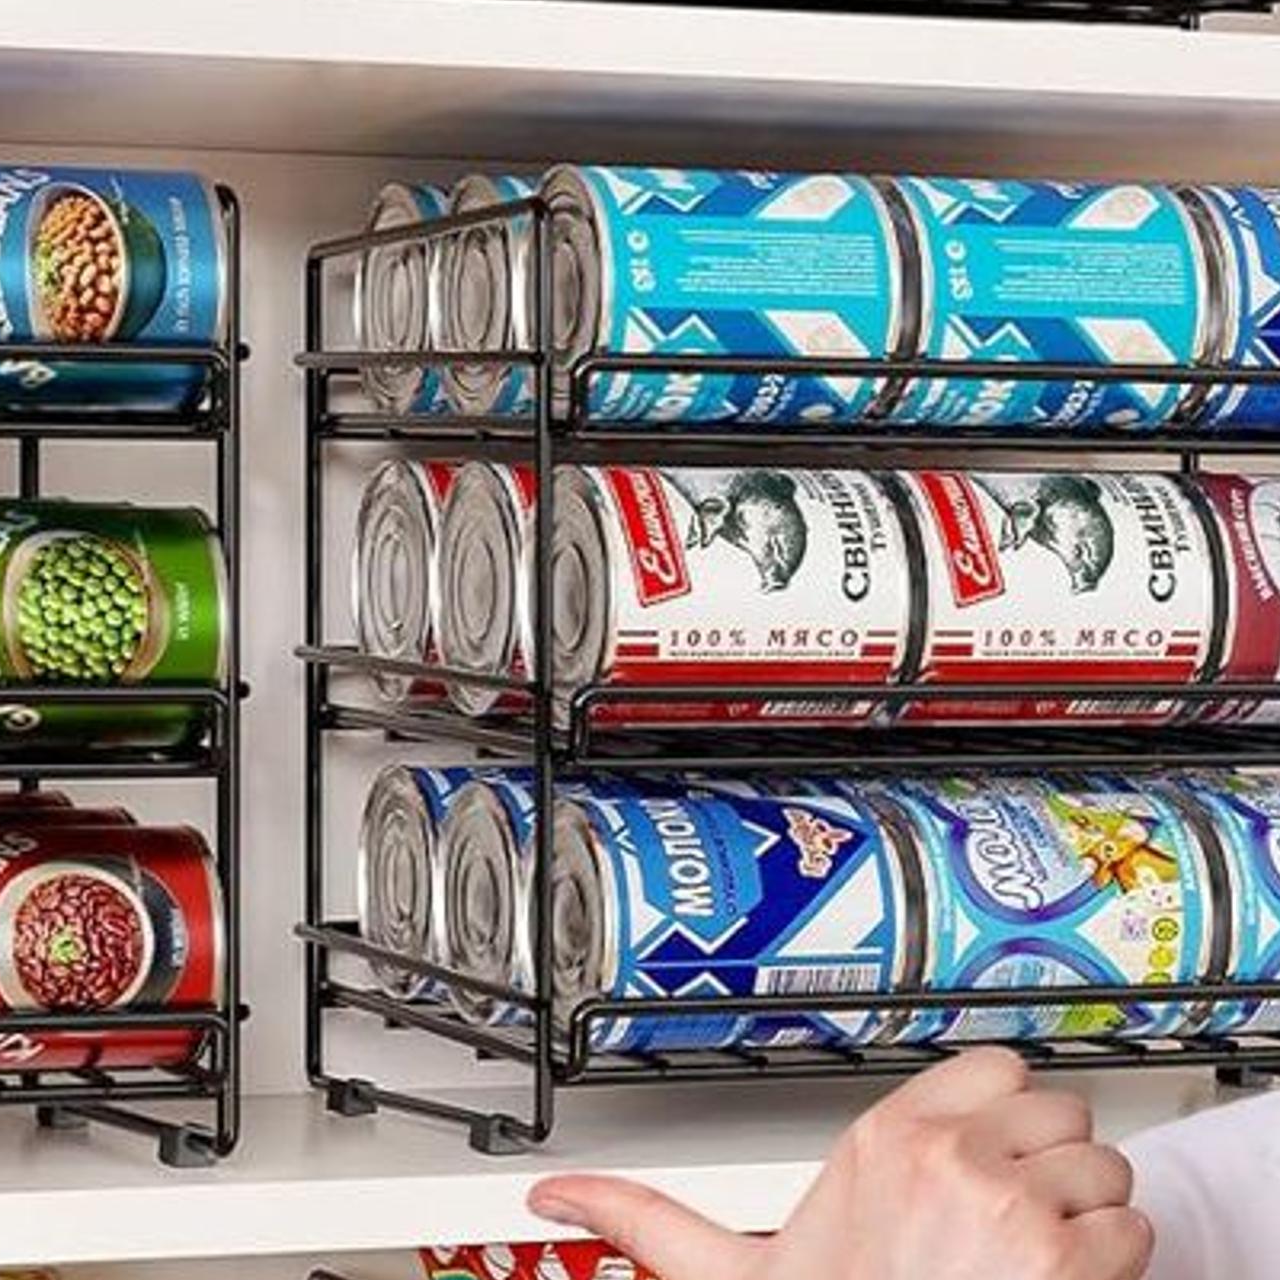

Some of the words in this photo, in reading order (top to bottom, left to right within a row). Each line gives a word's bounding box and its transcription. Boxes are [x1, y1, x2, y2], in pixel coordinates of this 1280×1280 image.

[669, 629, 748, 649] 100%
[767, 628, 861, 649] МЯСО
[984, 629, 1057, 649] 100%
[1074, 629, 1165, 649] МЯСО
